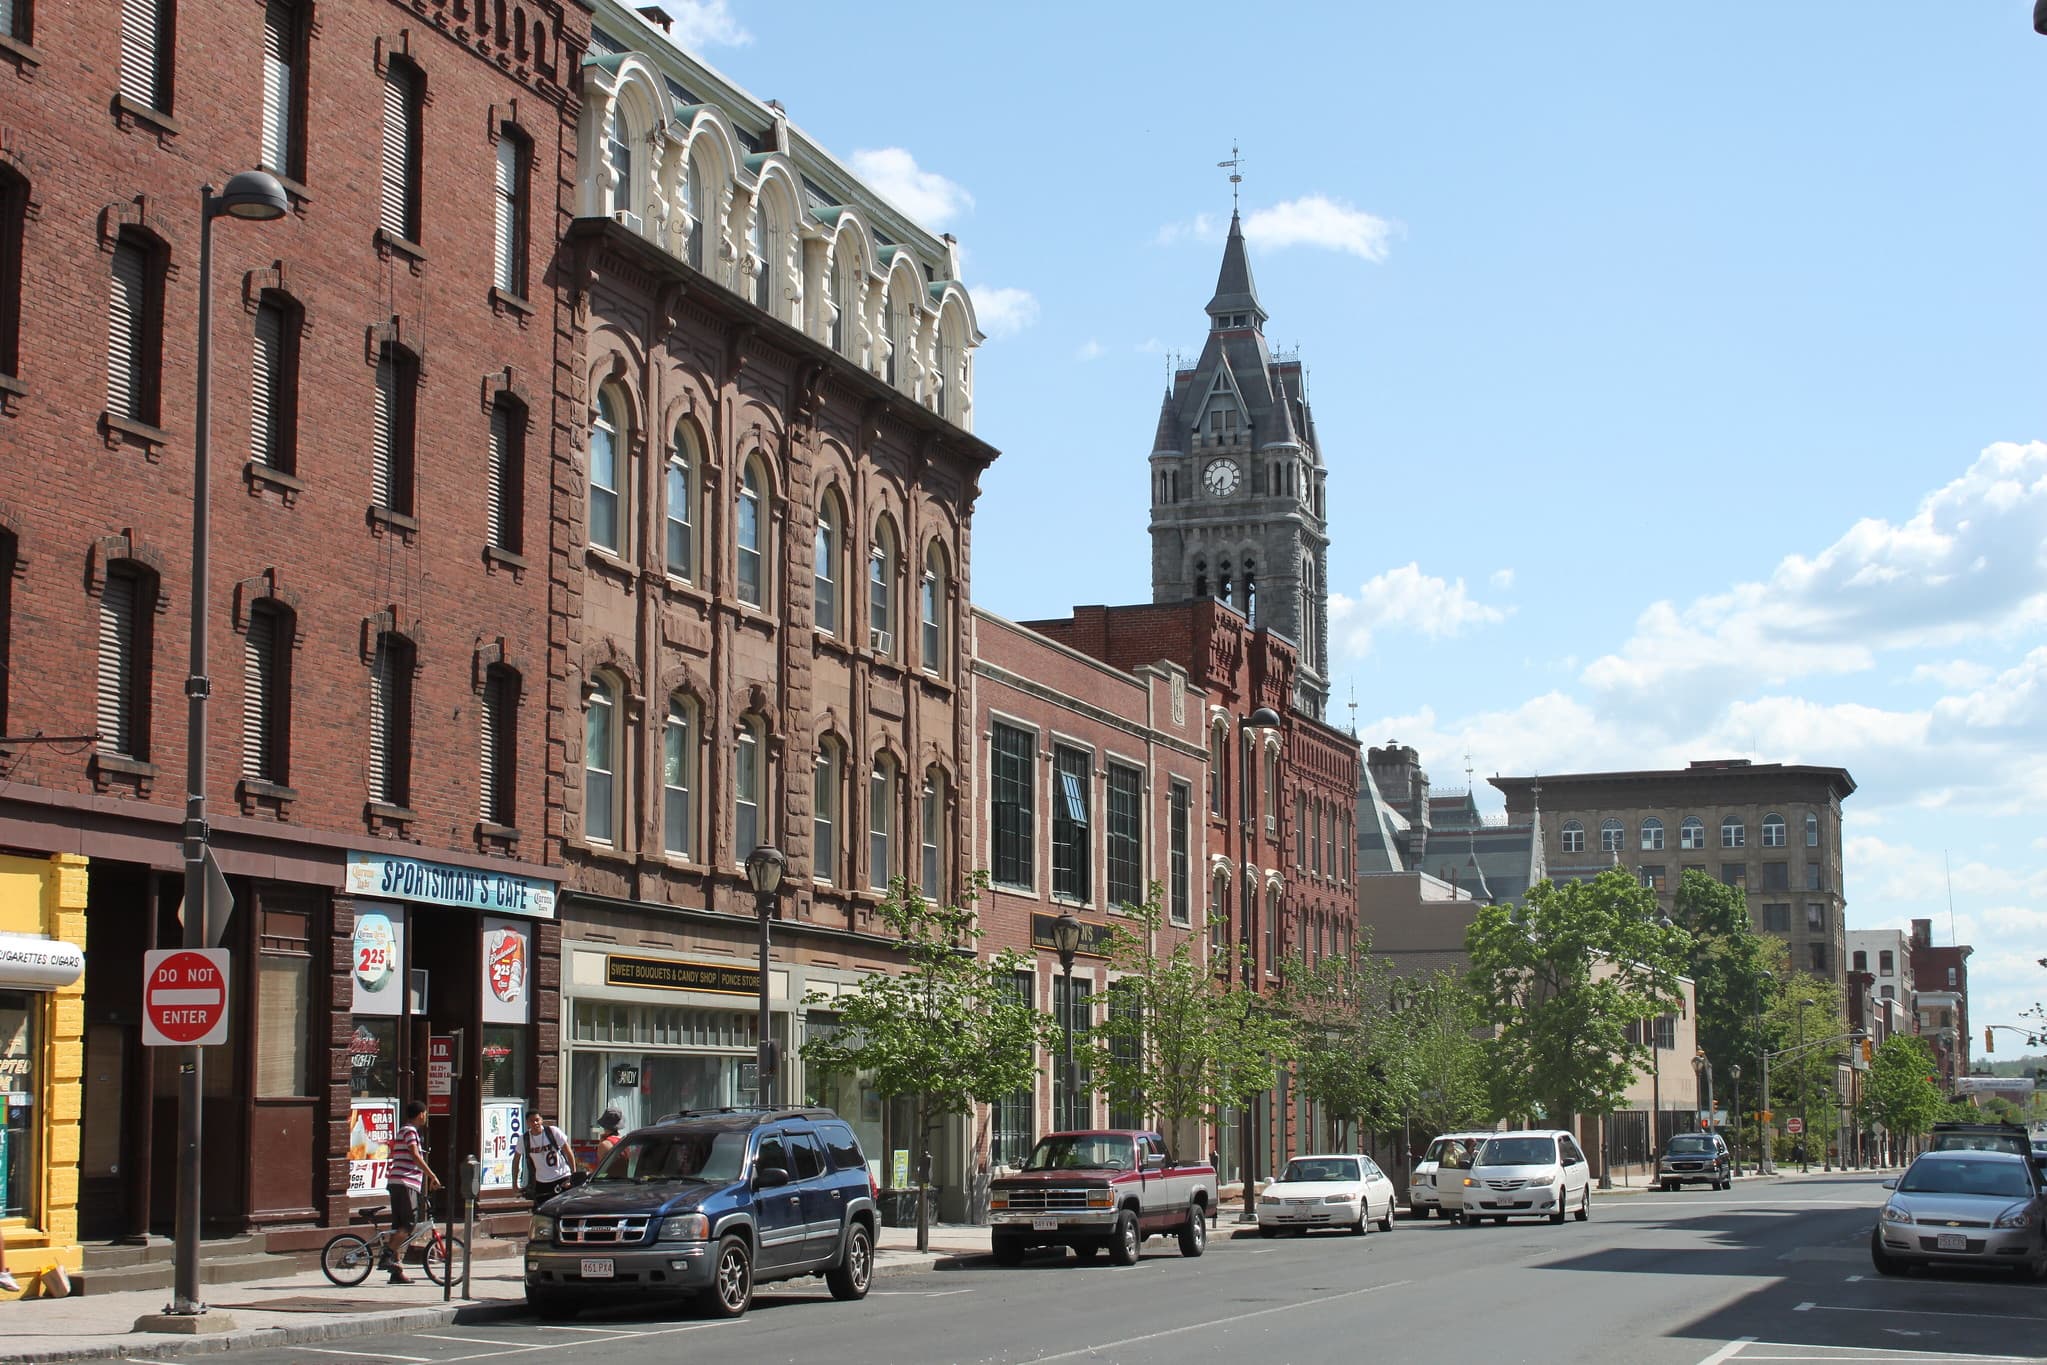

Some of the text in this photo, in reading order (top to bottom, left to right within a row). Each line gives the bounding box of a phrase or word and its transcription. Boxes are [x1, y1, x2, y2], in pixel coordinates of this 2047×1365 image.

[381, 860, 528, 909] SPORTSMAN'S CAFE
[0, 950, 80, 968] CIGARETTES CIGARS
[159, 968, 214, 982] DO NOT
[611, 963, 717, 985] SWEET BOUQUETS & CANDY SHOP
[721, 974, 741, 986] PONCE
[162, 1010, 207, 1024] ENTER
[433, 1044, 449, 1056] I.D.
[0, 1059, 32, 1075] PTED
[371, 1113, 393, 1124] GRAB
[371, 1130, 393, 1141] BUDS
[509, 1107, 521, 1157] ROCK
[546, 1151, 558, 1168] 6
[583, 1263, 612, 1273] 461 PX4
